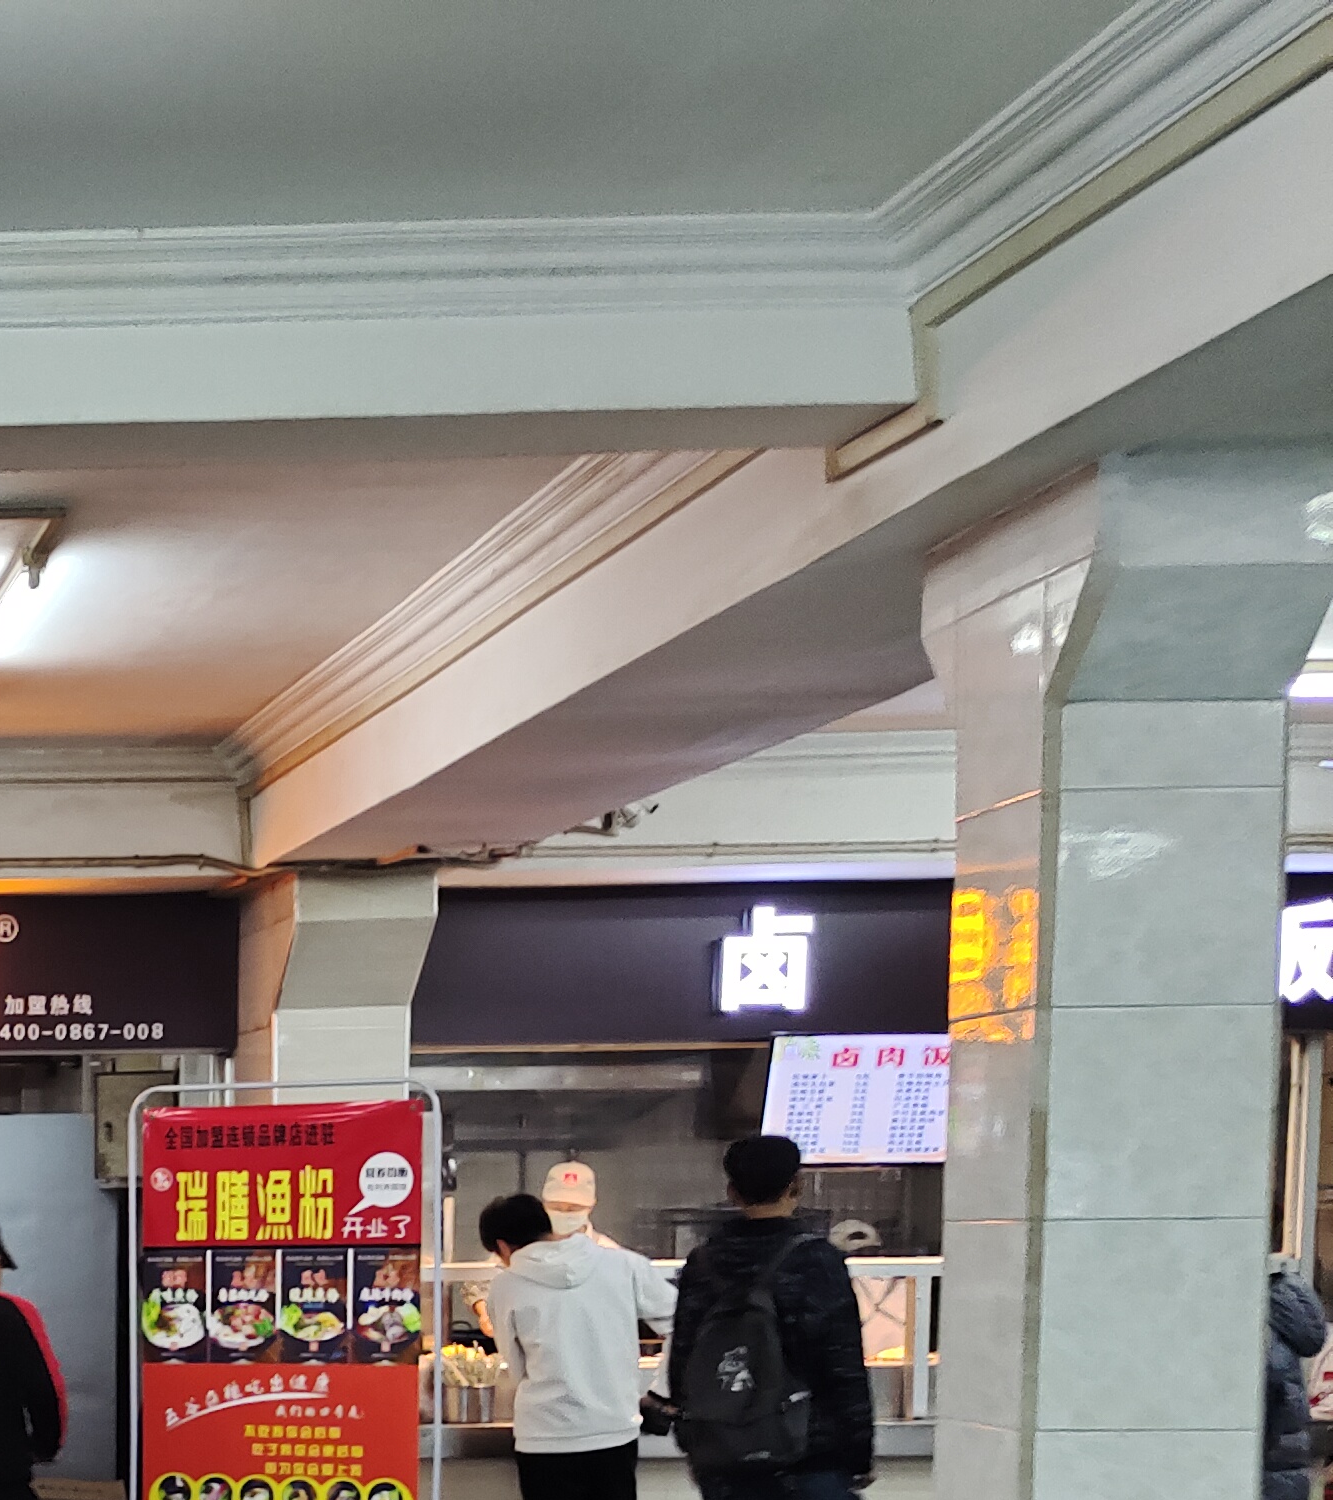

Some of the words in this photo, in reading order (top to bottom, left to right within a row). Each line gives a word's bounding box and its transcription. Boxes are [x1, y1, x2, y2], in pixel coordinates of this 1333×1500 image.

[720, 905, 816, 1013] 卤
[4, 994, 93, 1016] 加盟热线
[340, 1214, 412, 1239] 开业了
